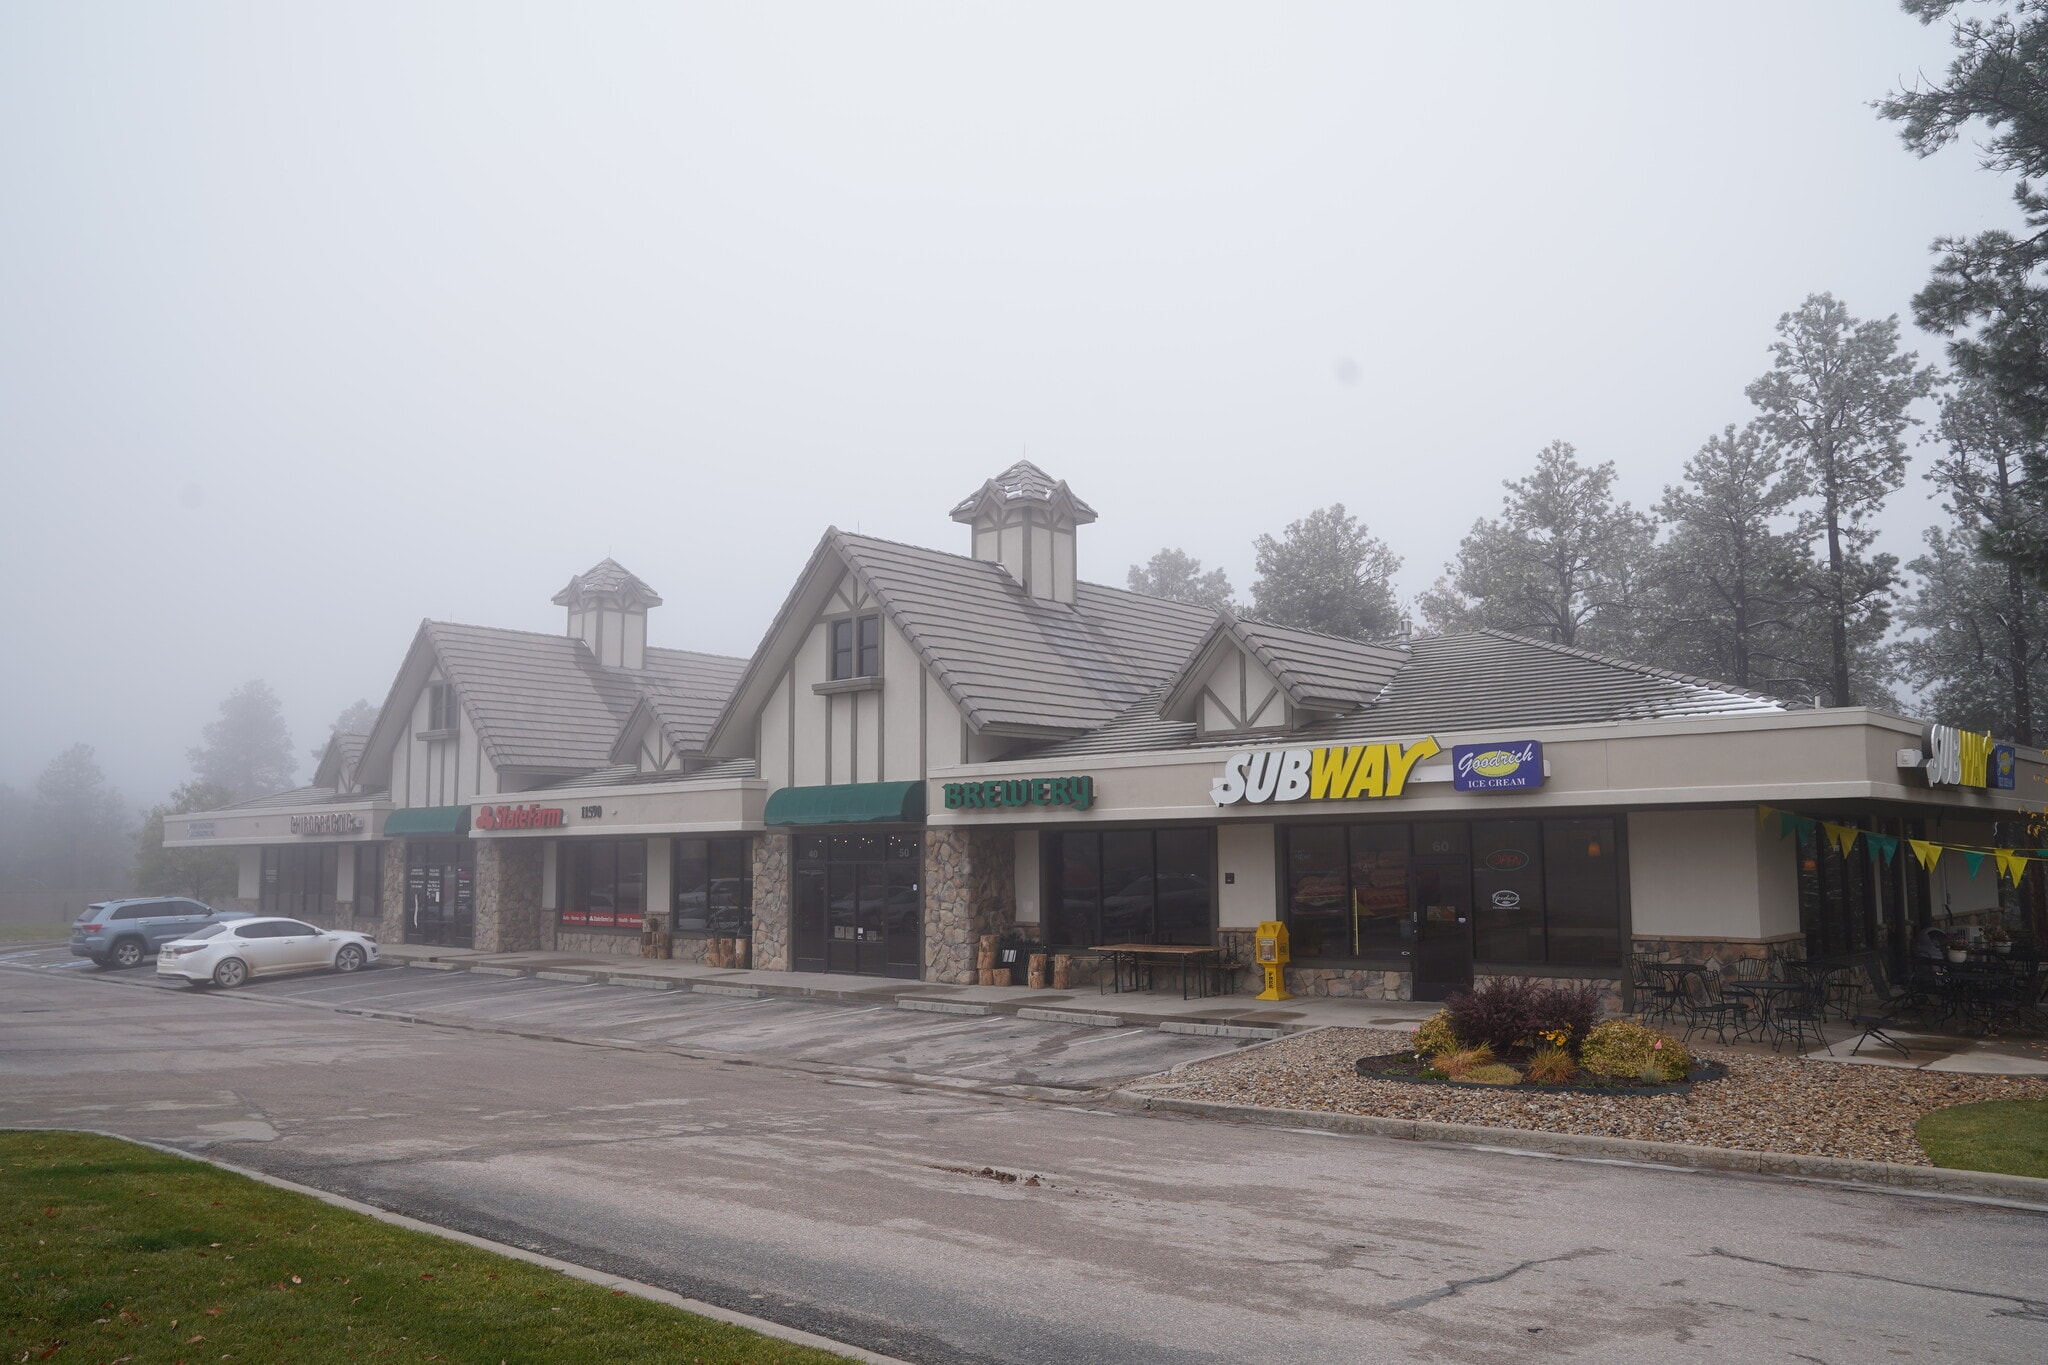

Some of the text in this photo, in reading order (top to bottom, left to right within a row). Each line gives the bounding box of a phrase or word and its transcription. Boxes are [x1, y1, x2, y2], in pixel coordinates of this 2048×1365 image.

[1458, 743, 1533, 777] Goodrich
[1209, 735, 1440, 807] SUBWAY
[1468, 777, 1526, 788] ICE CREAM
[942, 775, 1093, 811] BREWERY
[291, 813, 353, 834] CHIROPRACTIC
[808, 849, 818, 858] 40
[899, 848, 910, 858] 50
[1432, 841, 1449, 852] 60
